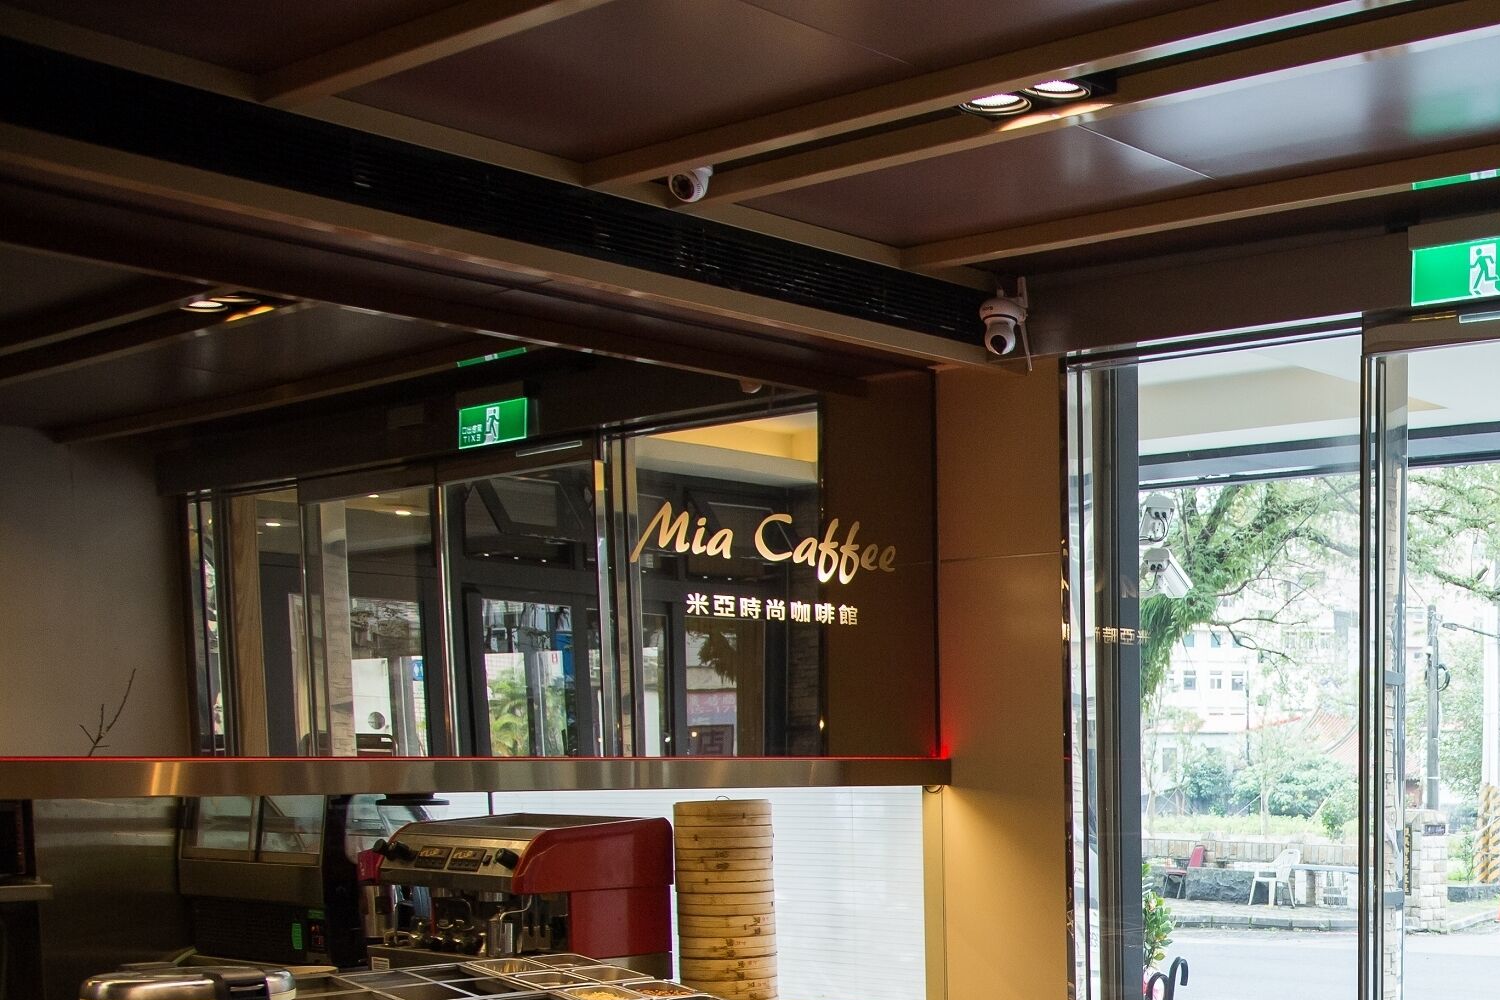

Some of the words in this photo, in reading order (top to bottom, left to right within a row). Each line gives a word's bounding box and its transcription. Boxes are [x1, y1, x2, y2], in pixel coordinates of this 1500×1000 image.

[630, 500, 734, 563] Mia
[754, 513, 897, 585] Caffee
[686, 591, 858, 626] 米亞時尚咖啡館
